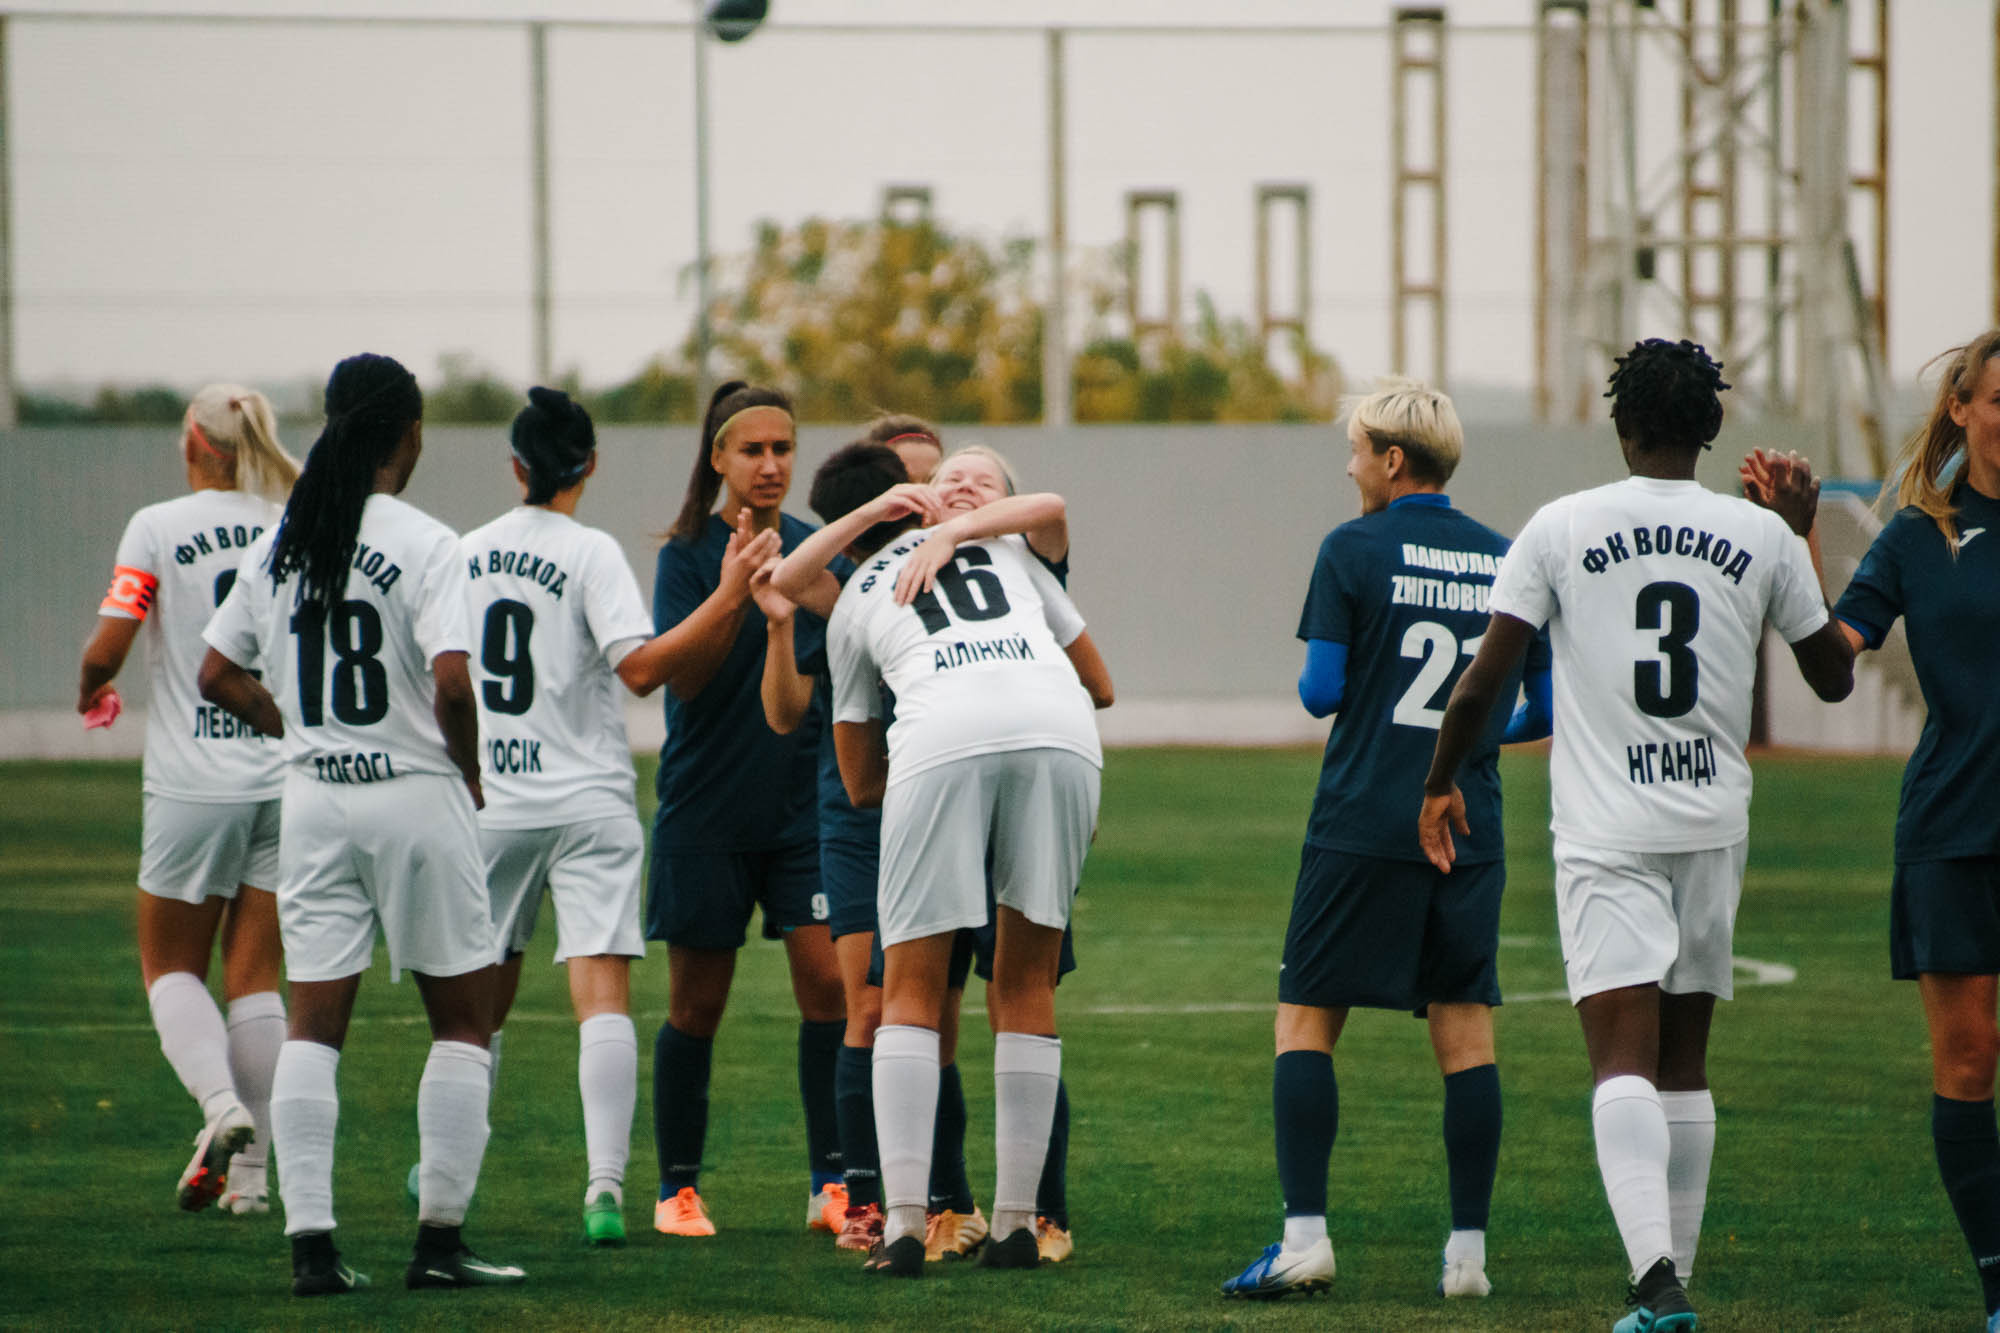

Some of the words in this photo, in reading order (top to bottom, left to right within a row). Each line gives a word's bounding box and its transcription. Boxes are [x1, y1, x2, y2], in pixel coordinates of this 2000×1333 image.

[175, 531, 213, 566] ФК
[215, 525, 264, 549] ВОС
[353, 543, 402, 596] ХОД
[1582, 532, 1631, 574] ФК
[1633, 525, 1753, 585] ВОСХОД
[468, 554, 482, 580] К
[488, 550, 567, 601] ВОСХОД
[892, 545, 1011, 635] 16
[1392, 575, 1497, 615] ZHITLOBU
[289, 599, 389, 727] 18
[482, 598, 535, 716] 9
[1392, 621, 1488, 729] 2
[1634, 581, 1700, 718] 3
[488, 738, 542, 775] ОСІК
[1627, 737, 1716, 787] НГАНДІ
[811, 893, 830, 920] 9
